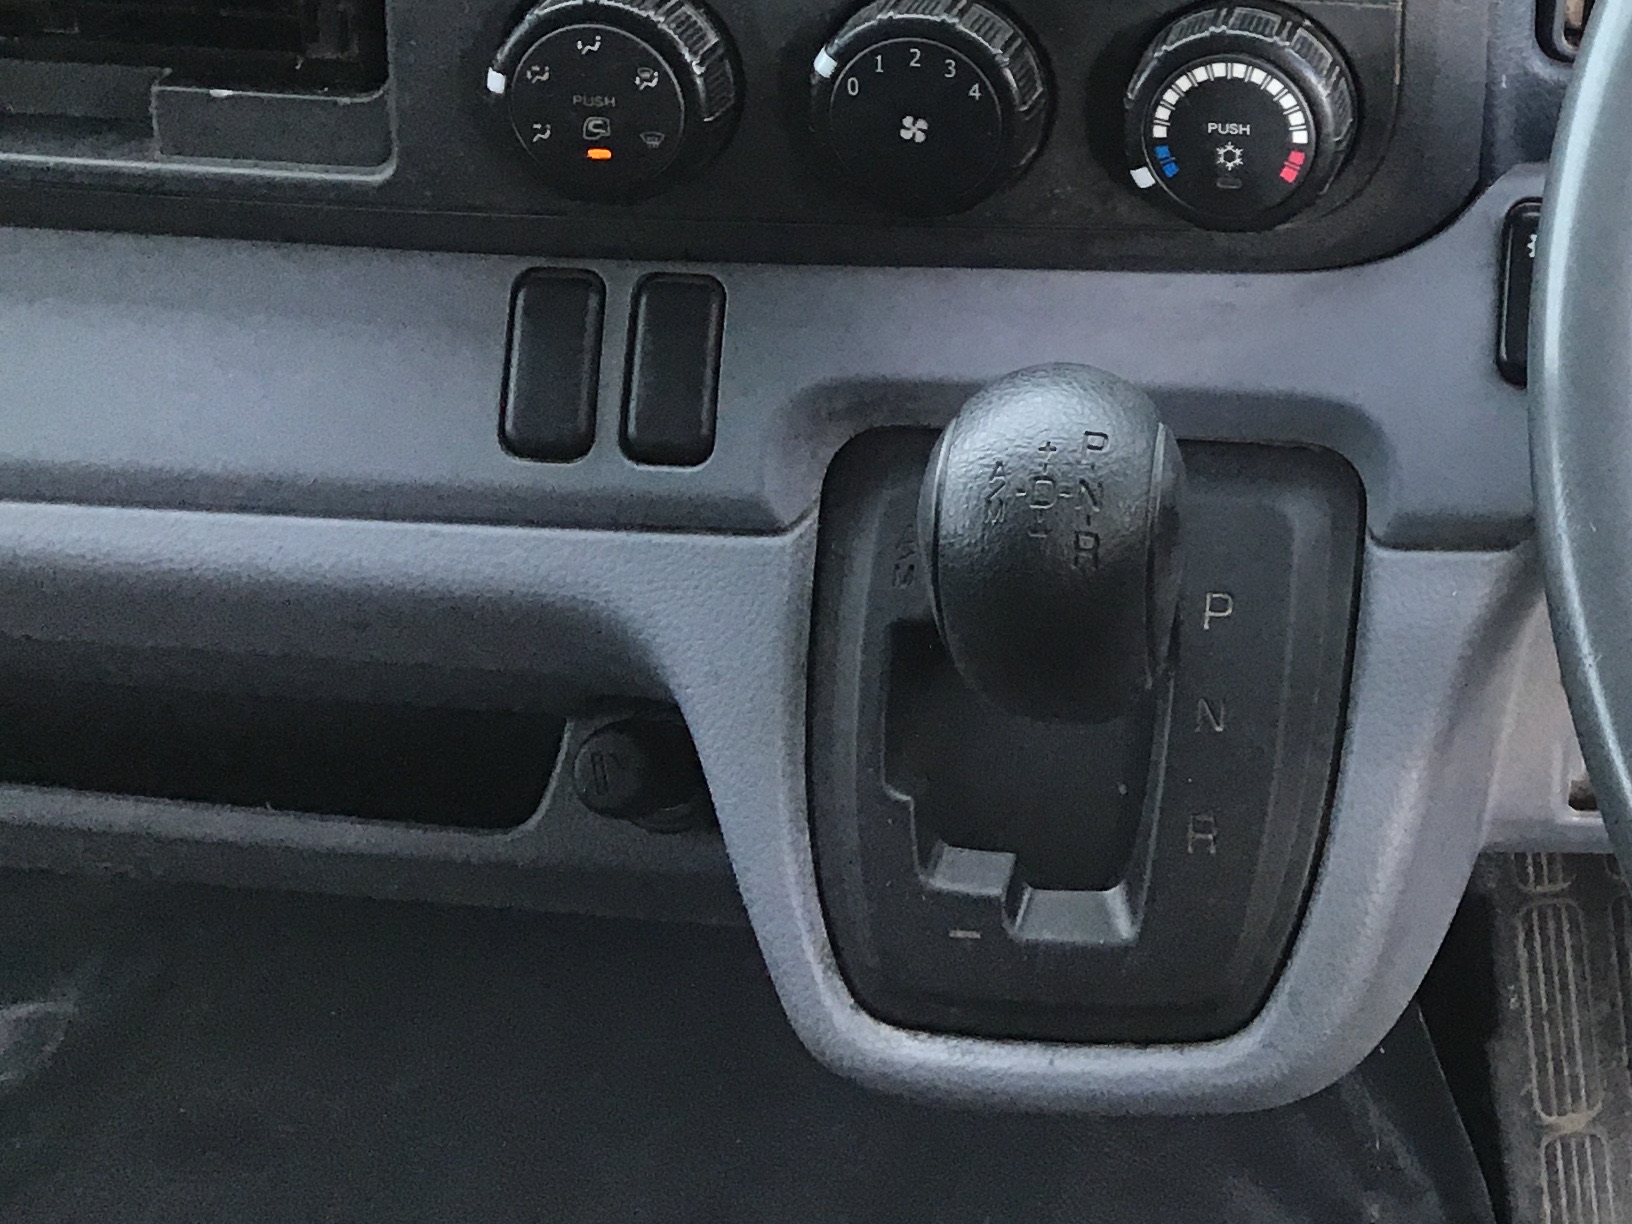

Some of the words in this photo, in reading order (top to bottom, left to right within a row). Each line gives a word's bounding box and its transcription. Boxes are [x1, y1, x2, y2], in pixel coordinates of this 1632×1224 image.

[874, 53, 885, 74] 1
[908, 47, 922, 68] 2
[943, 58, 957, 79] 3
[846, 76, 860, 97] 0
[967, 82, 983, 101] 4
[572, 93, 617, 108] PUSH
[1207, 121, 1251, 136] PUSH
[1081, 430, 1110, 460] P
[1029, 475, 1057, 510] D
[1074, 478, 1105, 513] N
[1072, 529, 1100, 571] R
[1202, 591, 1235, 630] P
[1194, 696, 1226, 733] N
[1186, 812, 1218, 855] R
